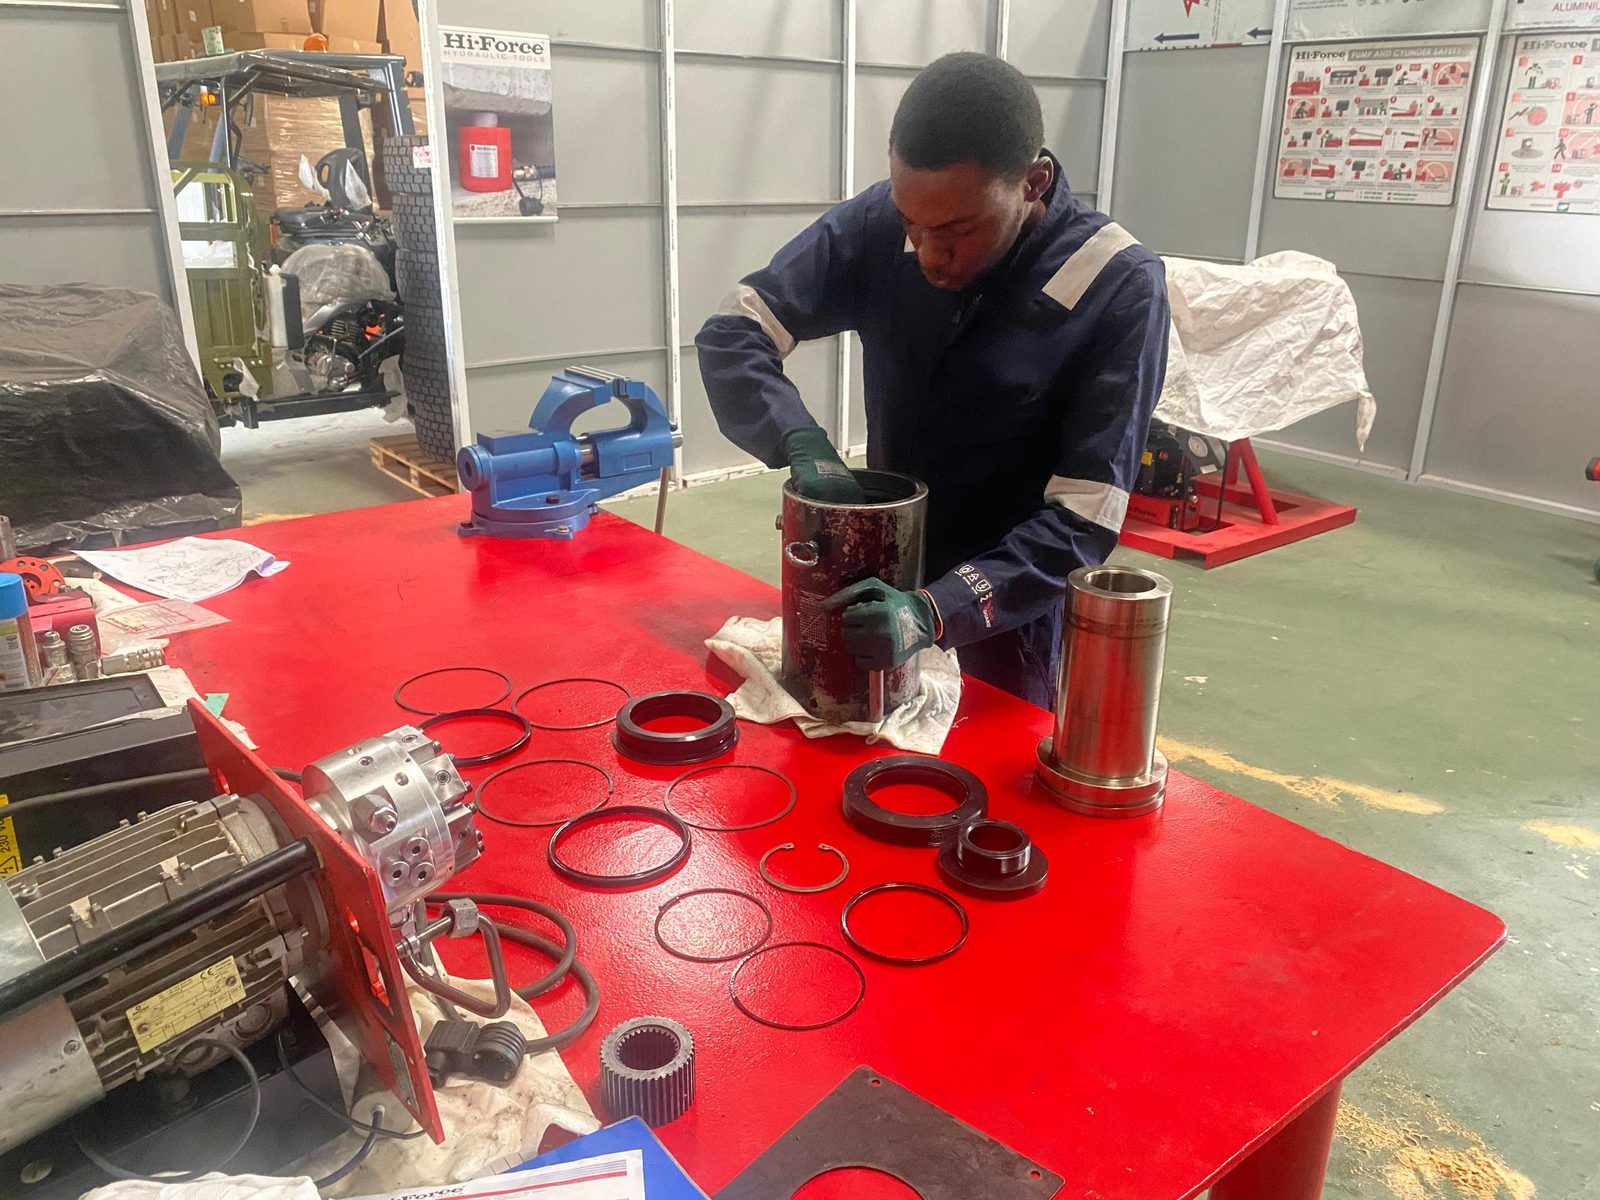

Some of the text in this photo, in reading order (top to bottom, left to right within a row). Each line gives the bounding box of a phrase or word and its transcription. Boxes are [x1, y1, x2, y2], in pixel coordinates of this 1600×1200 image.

[443, 50, 546, 63] HYDRAULIC TOOLS
[1374, 49, 1392, 58] AND
[0, 834, 11, 854] 230
